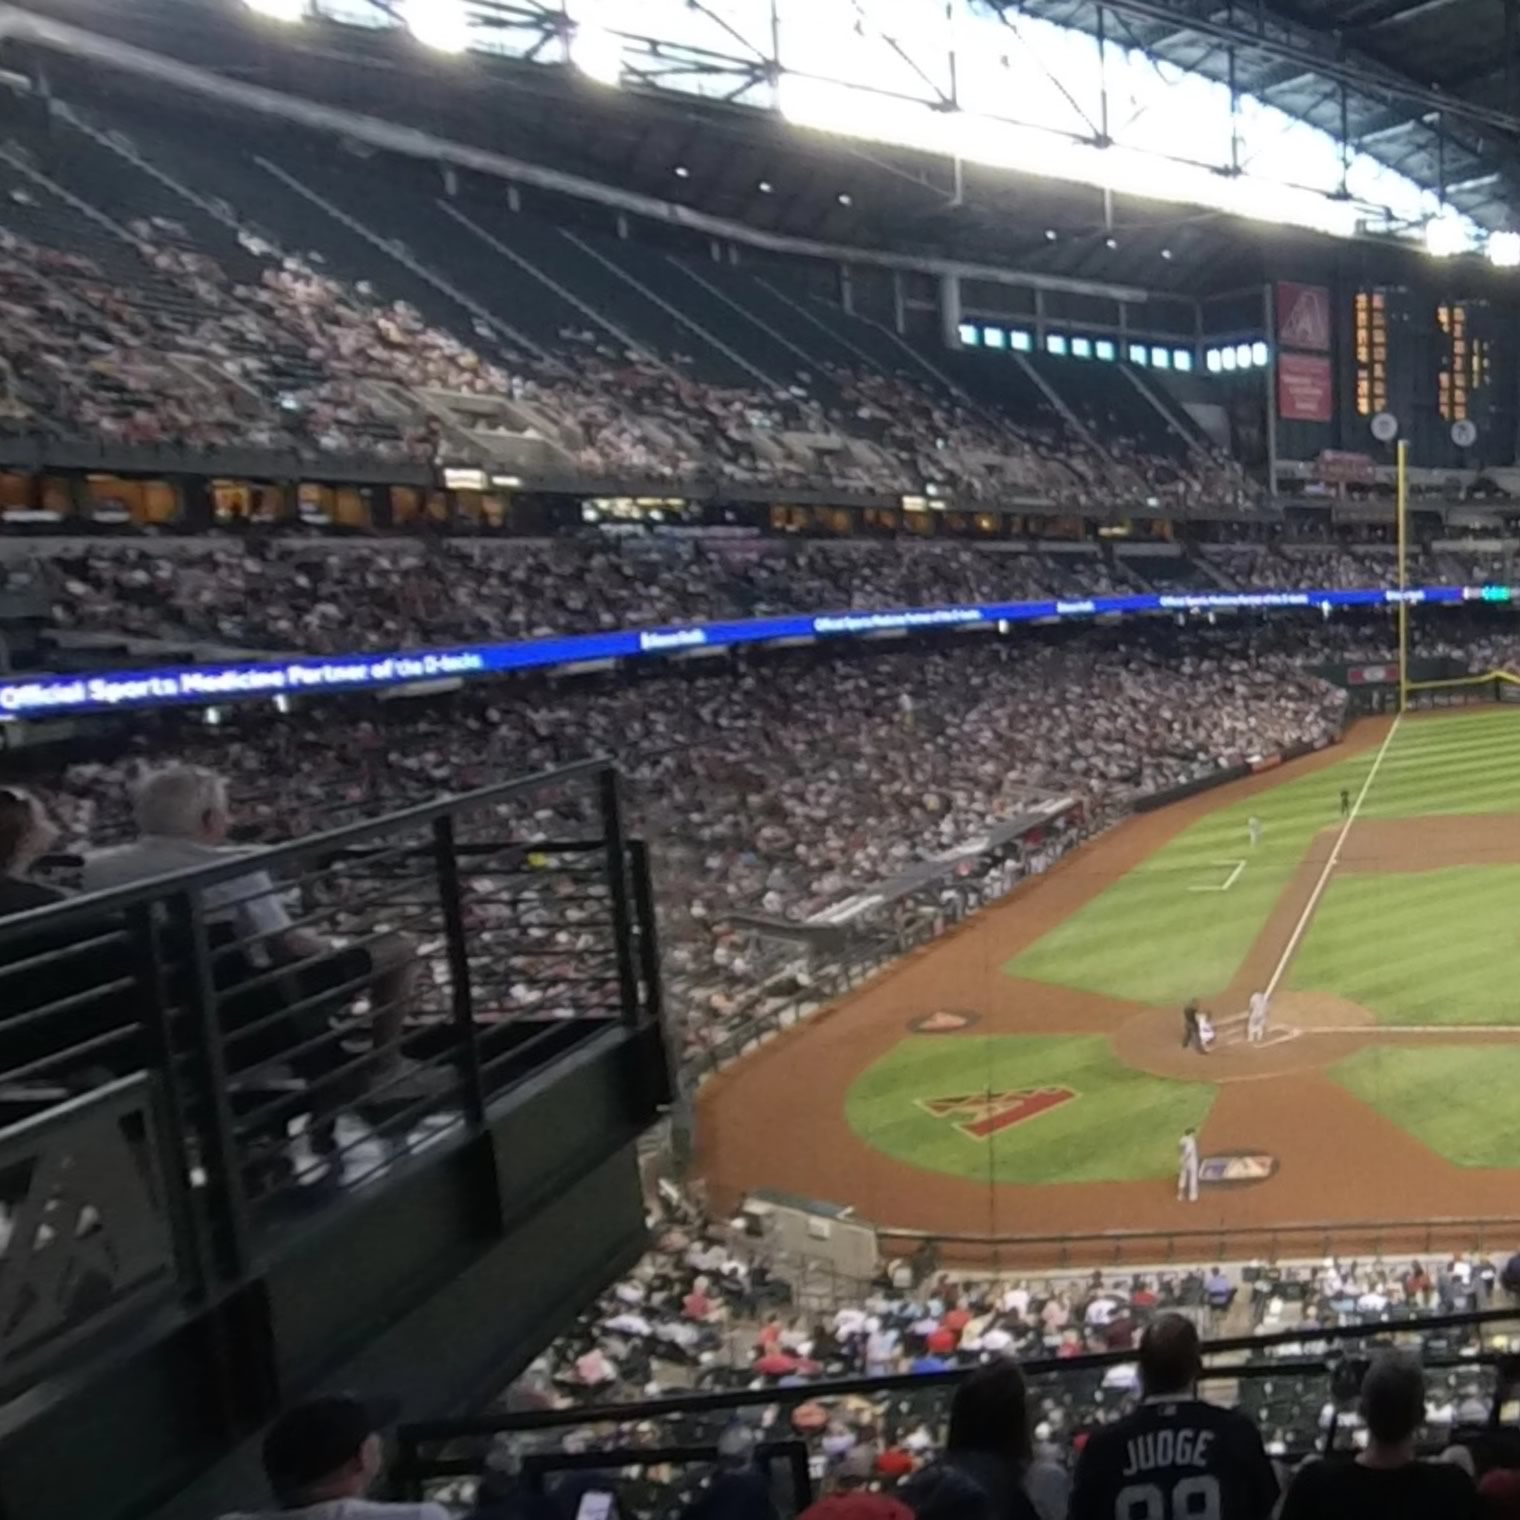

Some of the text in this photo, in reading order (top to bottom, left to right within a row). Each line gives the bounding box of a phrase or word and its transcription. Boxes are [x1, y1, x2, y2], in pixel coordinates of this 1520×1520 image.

[0, 679, 87, 710] Official
[87, 677, 178, 704] Sports
[179, 669, 285, 694] Medicine
[286, 664, 369, 686] Partner
[370, 658, 394, 680] of
[394, 657, 423, 678] the
[1122, 1427, 1216, 1477] JUDGE
